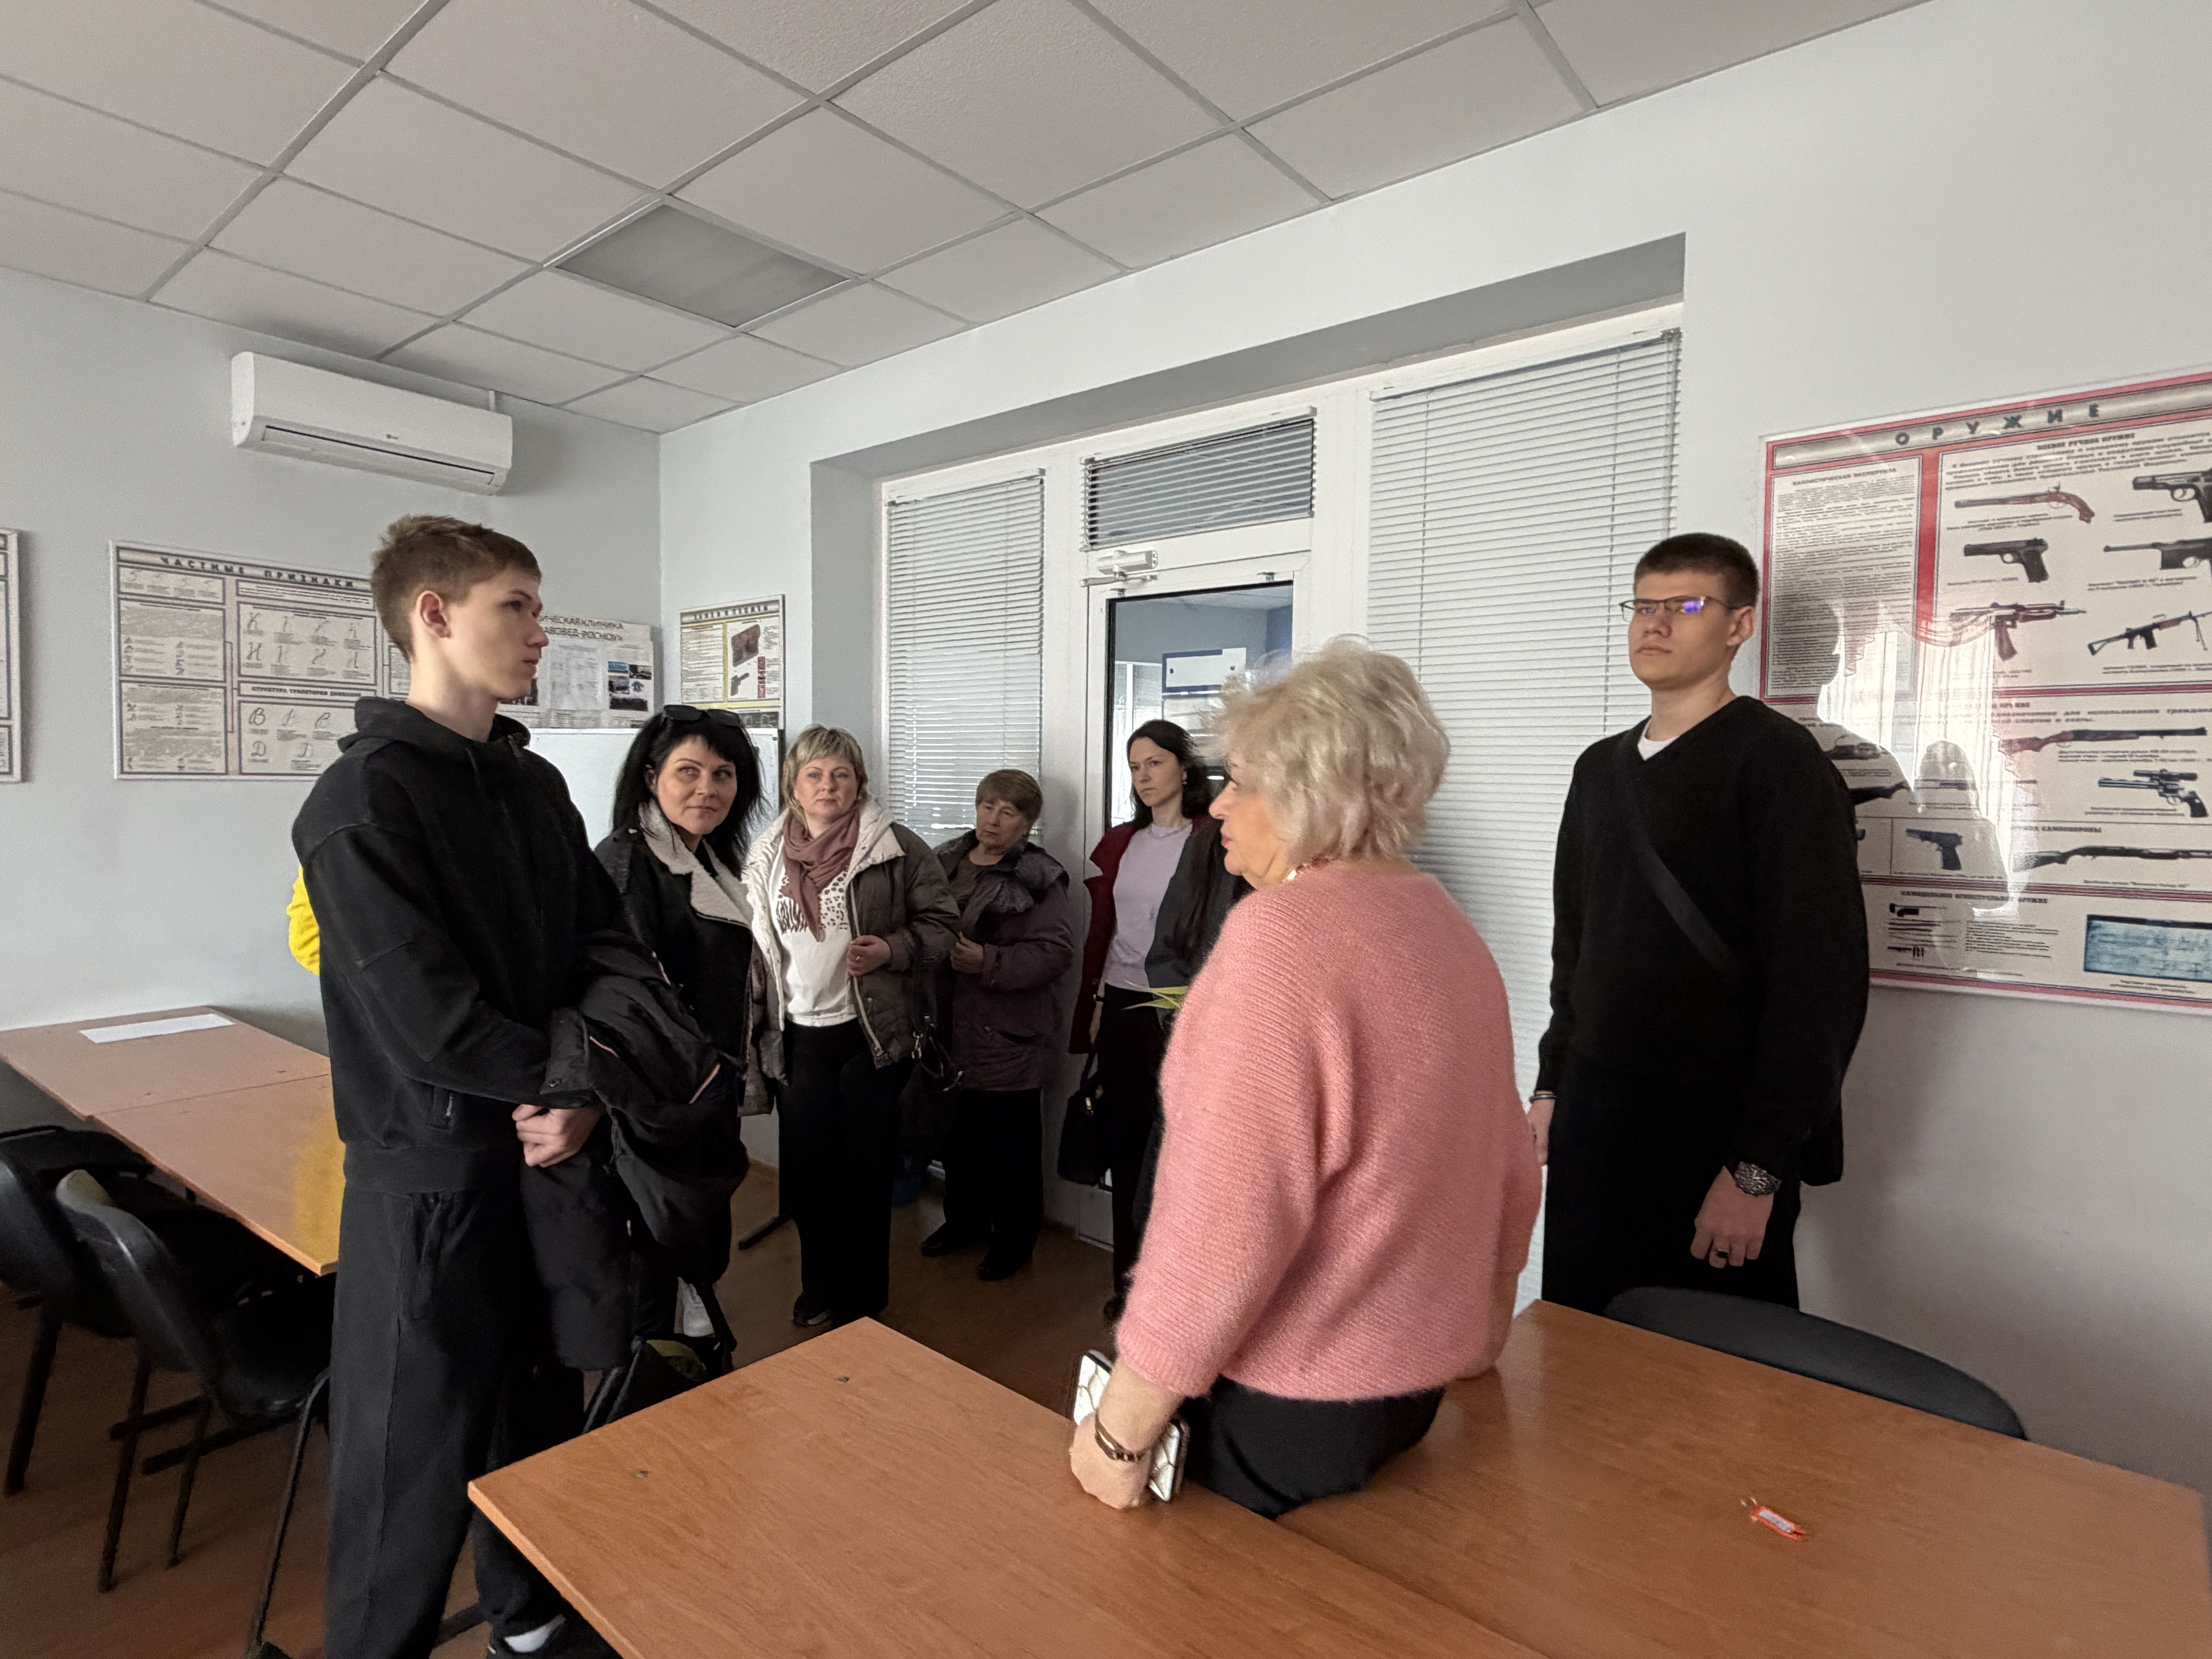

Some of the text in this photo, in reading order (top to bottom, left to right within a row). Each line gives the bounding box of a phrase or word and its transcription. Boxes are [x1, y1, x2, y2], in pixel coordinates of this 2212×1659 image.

[1895, 403, 2099, 446] ОРУЖИЕ
[160, 557, 353, 588] ЧАСТНЫЕ ПРИЗНАКИ
